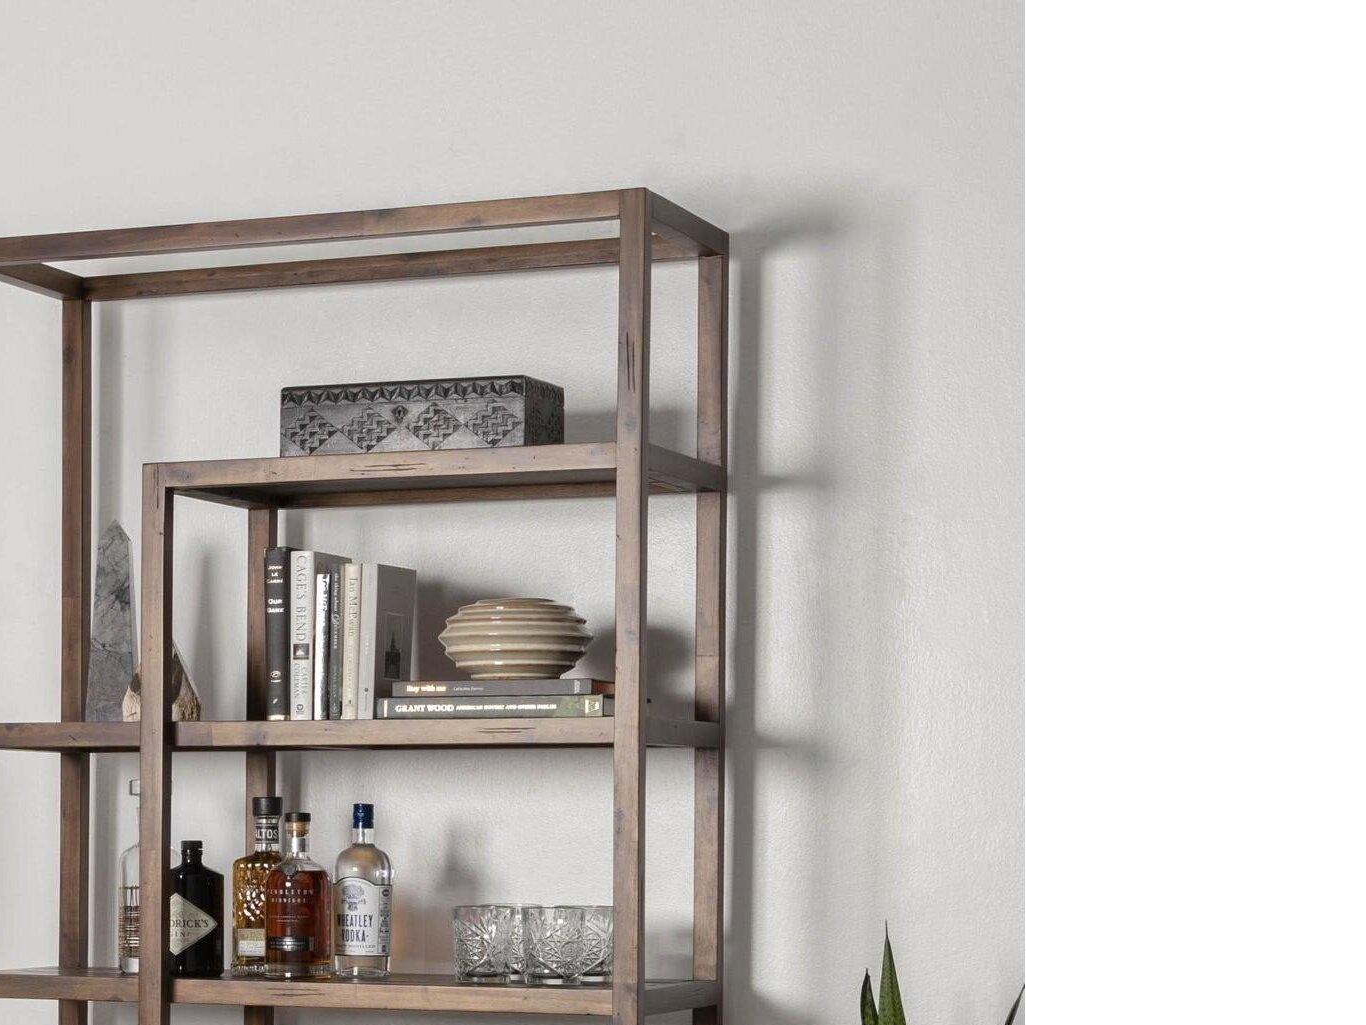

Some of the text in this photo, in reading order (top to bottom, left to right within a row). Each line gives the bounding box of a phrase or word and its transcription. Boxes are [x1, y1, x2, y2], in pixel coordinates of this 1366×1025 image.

[295, 555, 307, 642] CAGE'S BEND
[395, 704, 426, 712] GRANT
[427, 704, 454, 712] WOOD
[337, 914, 373, 927] WHEATLEY
